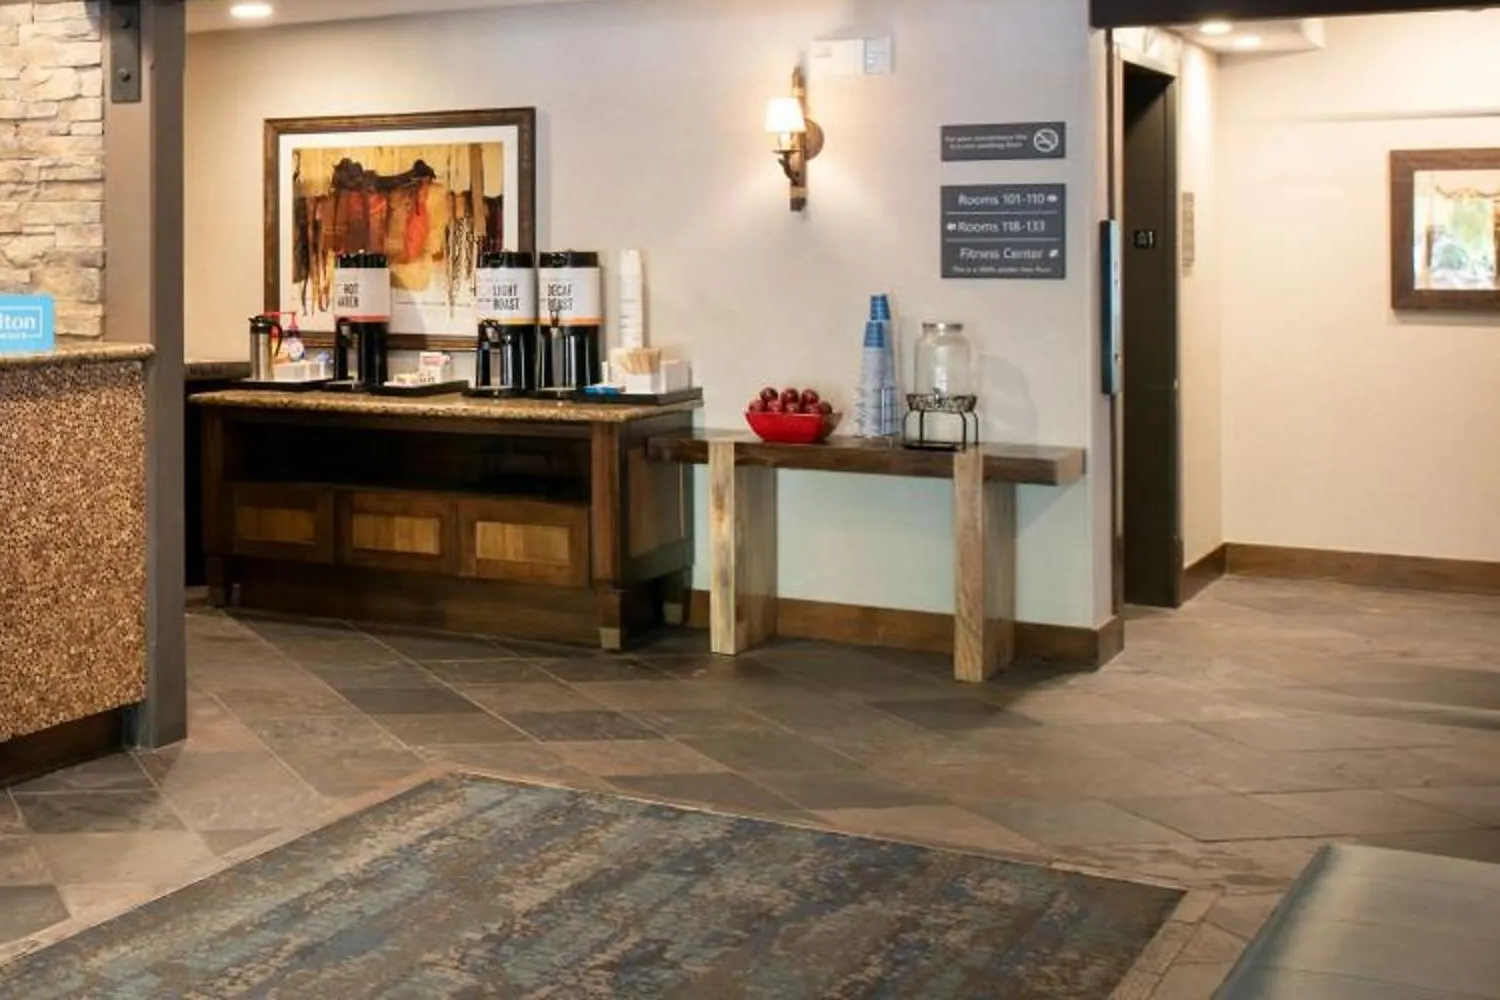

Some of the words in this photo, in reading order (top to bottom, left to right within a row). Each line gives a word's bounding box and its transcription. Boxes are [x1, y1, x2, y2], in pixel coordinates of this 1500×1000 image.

[958, 193, 999, 206] Rooms
[958, 221, 999, 233] Rooms
[960, 248, 1000, 259] Fitness
[1003, 248, 1044, 259] Center
